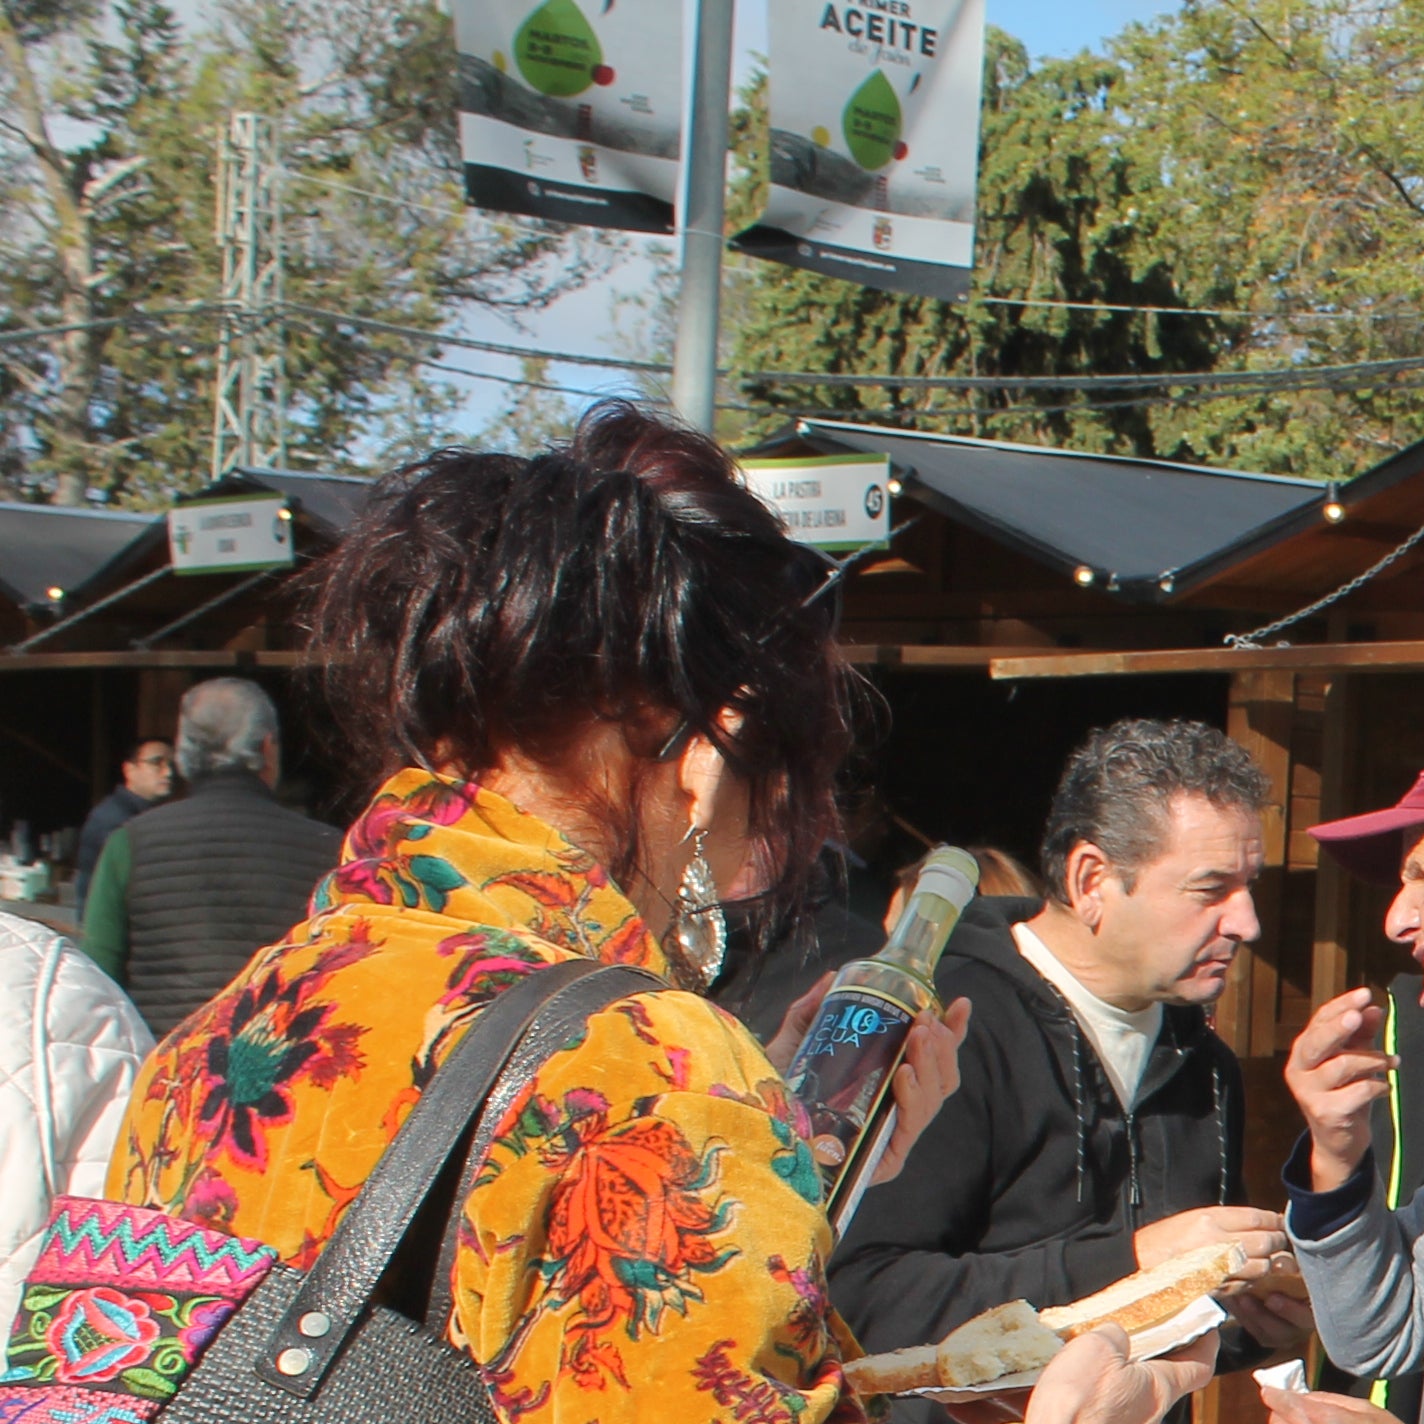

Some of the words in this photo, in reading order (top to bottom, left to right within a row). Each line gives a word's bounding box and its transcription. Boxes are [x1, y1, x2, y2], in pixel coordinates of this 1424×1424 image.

[847, 0, 911, 18] RIMER
[819, 3, 937, 58] ACEITE
[867, 490, 883, 512] 45
[813, 1027, 862, 1048] CUA
[806, 1042, 836, 1057] LIA
